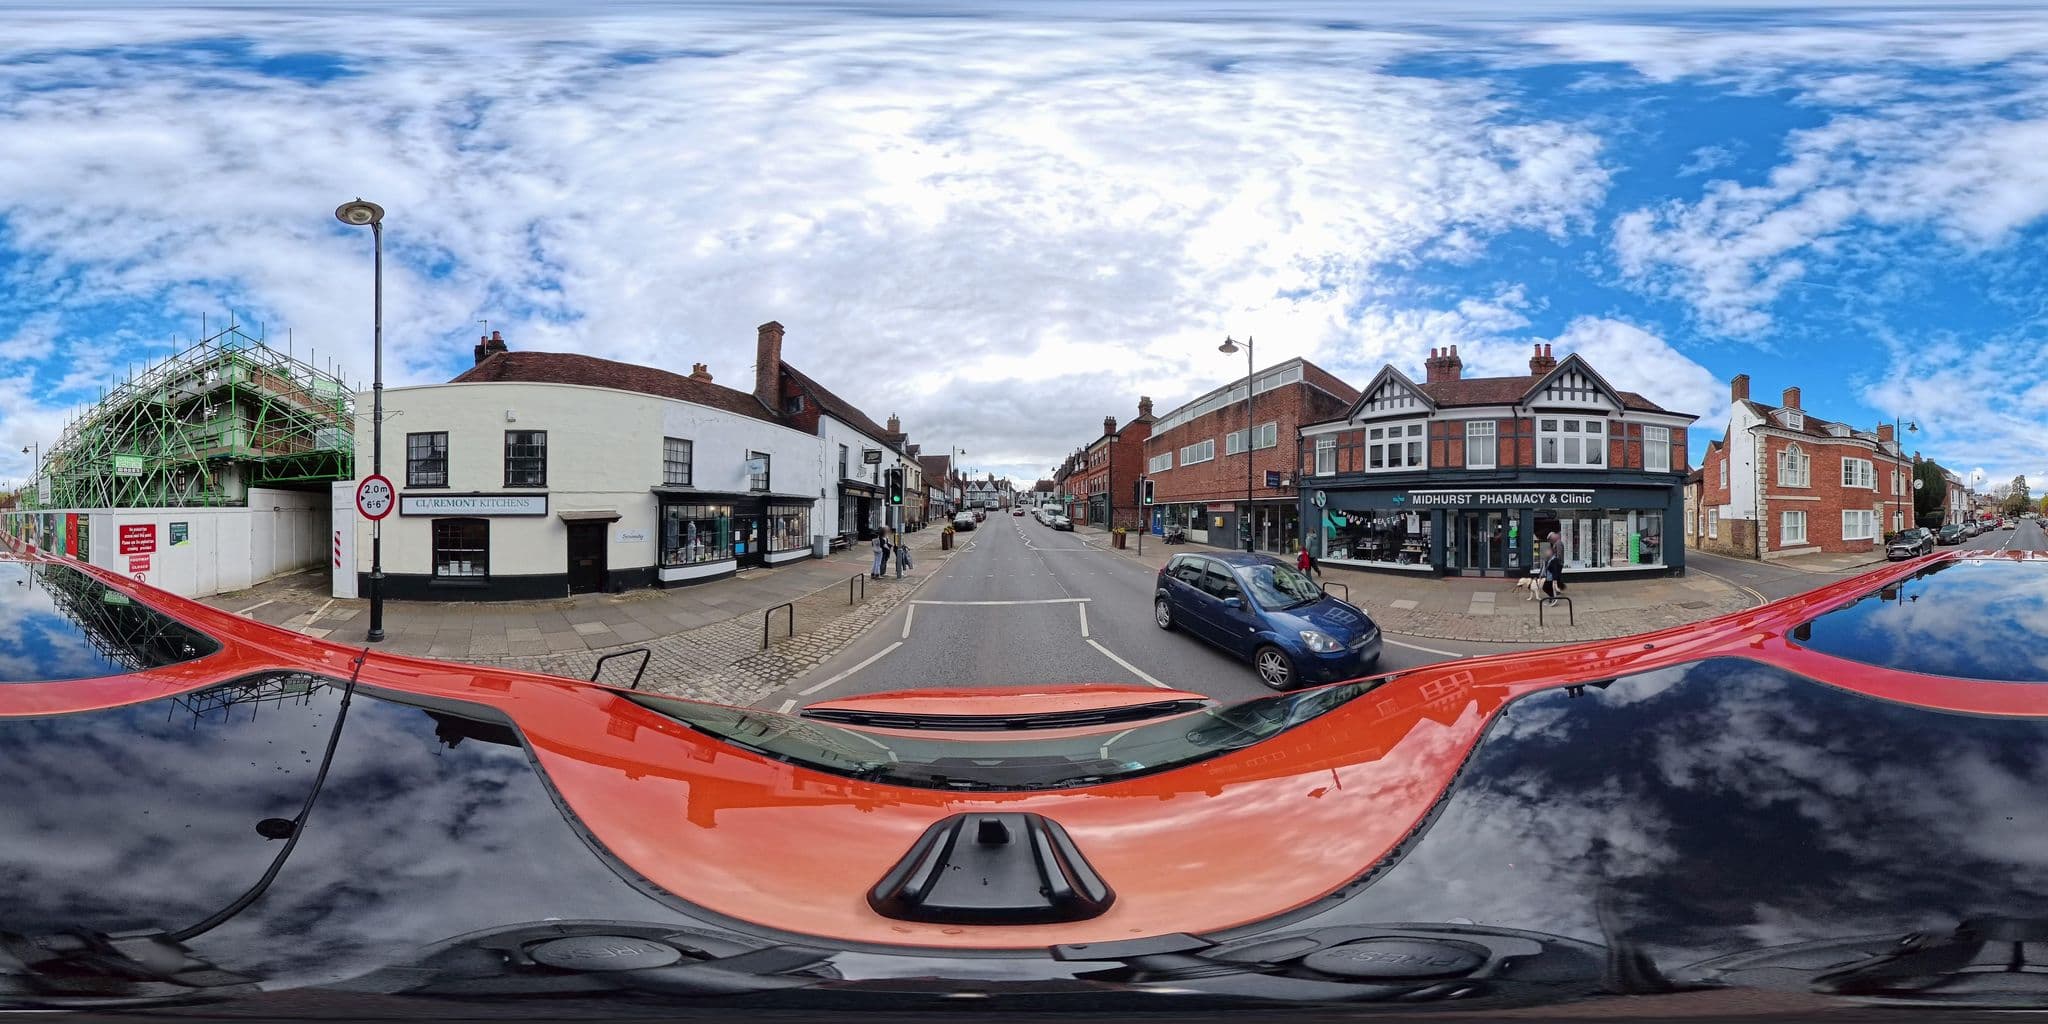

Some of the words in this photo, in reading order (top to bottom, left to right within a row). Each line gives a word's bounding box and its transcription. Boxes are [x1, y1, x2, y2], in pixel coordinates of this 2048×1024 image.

[416, 498, 476, 508] CLAREMONT
[480, 498, 530, 507] KITCHENS
[1412, 495, 1472, 505] MIDHURST
[1480, 494, 1545, 504] PHARMACY
[1549, 494, 1557, 503] &
[1560, 493, 1592, 503] Clinic
